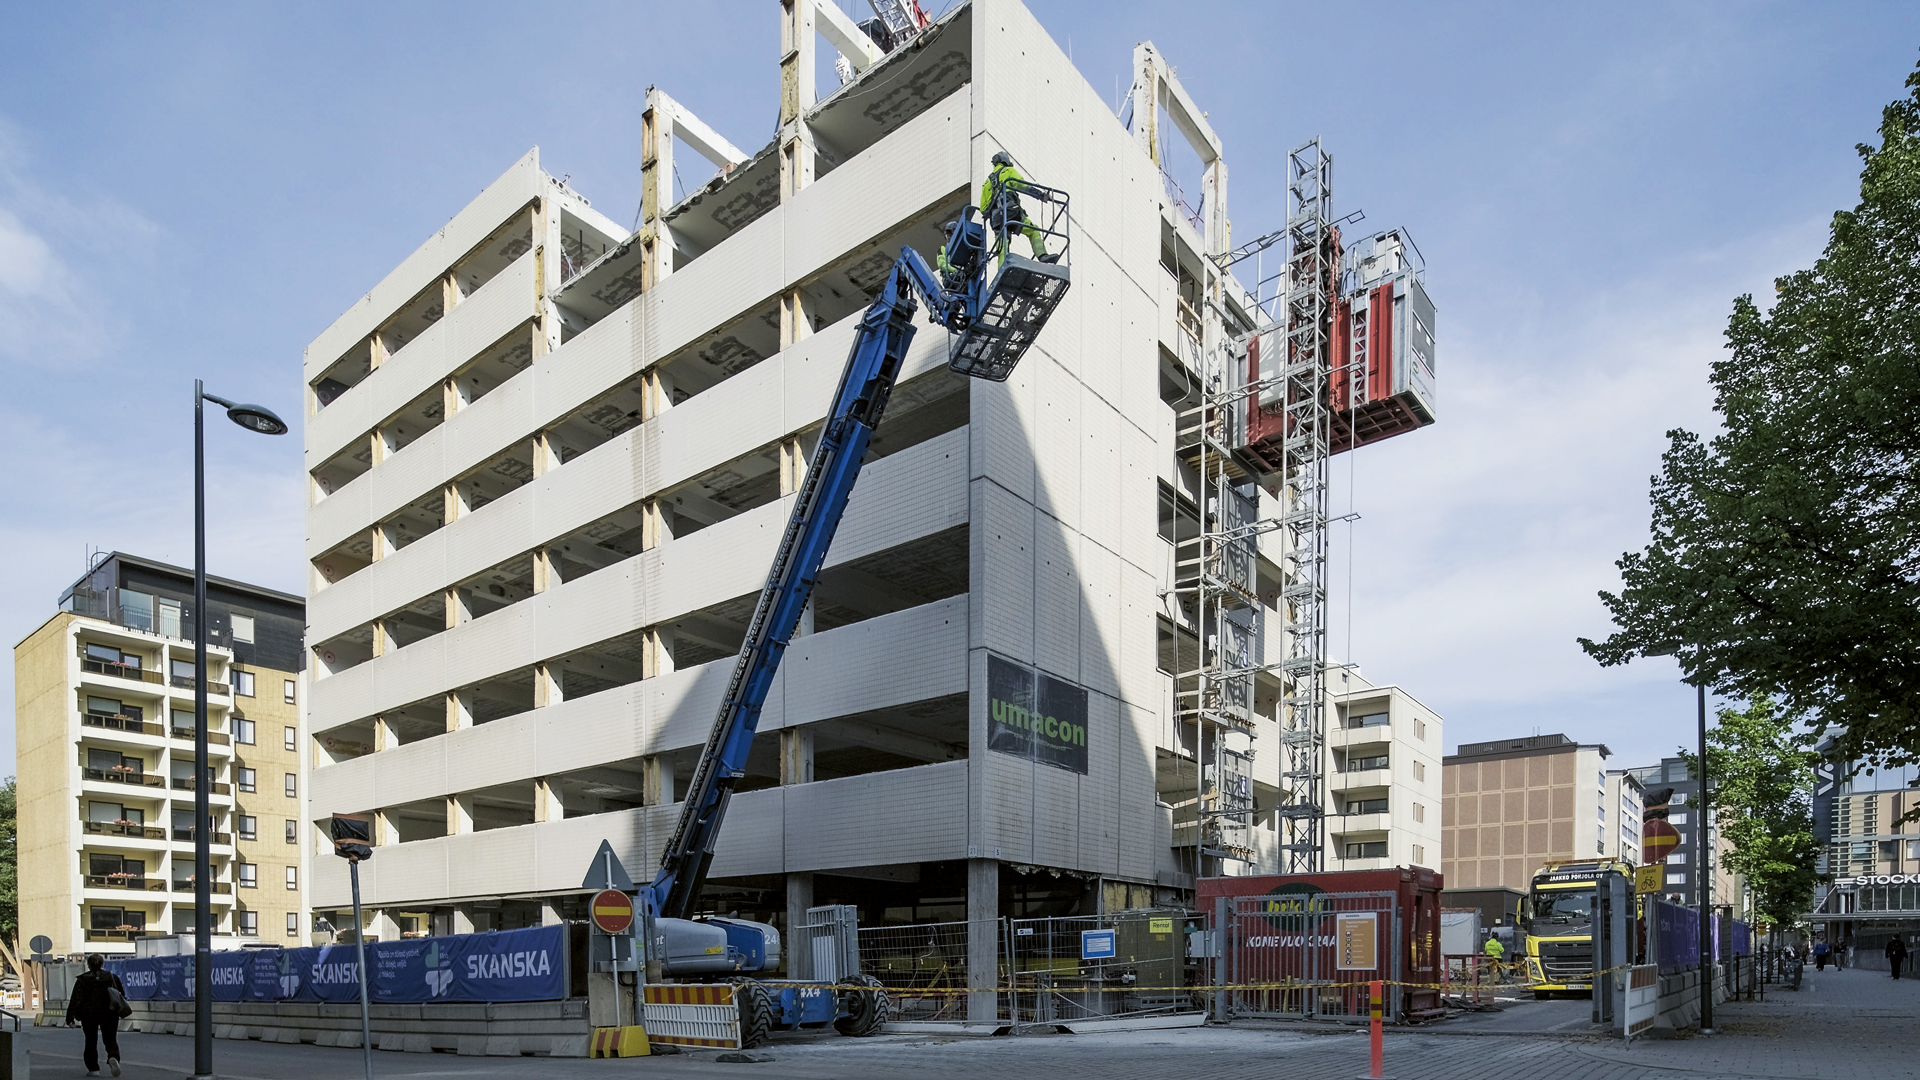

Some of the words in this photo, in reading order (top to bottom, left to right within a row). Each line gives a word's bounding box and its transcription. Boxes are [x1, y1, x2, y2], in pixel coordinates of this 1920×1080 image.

[992, 698, 1085, 747] umacon
[1856, 874, 1920, 886] STOCK
[311, 962, 359, 984] SKANSK
[467, 949, 551, 979] SKANSKA
[126, 970, 157, 987] SKANSKA
[211, 966, 245, 985] KANSKA
